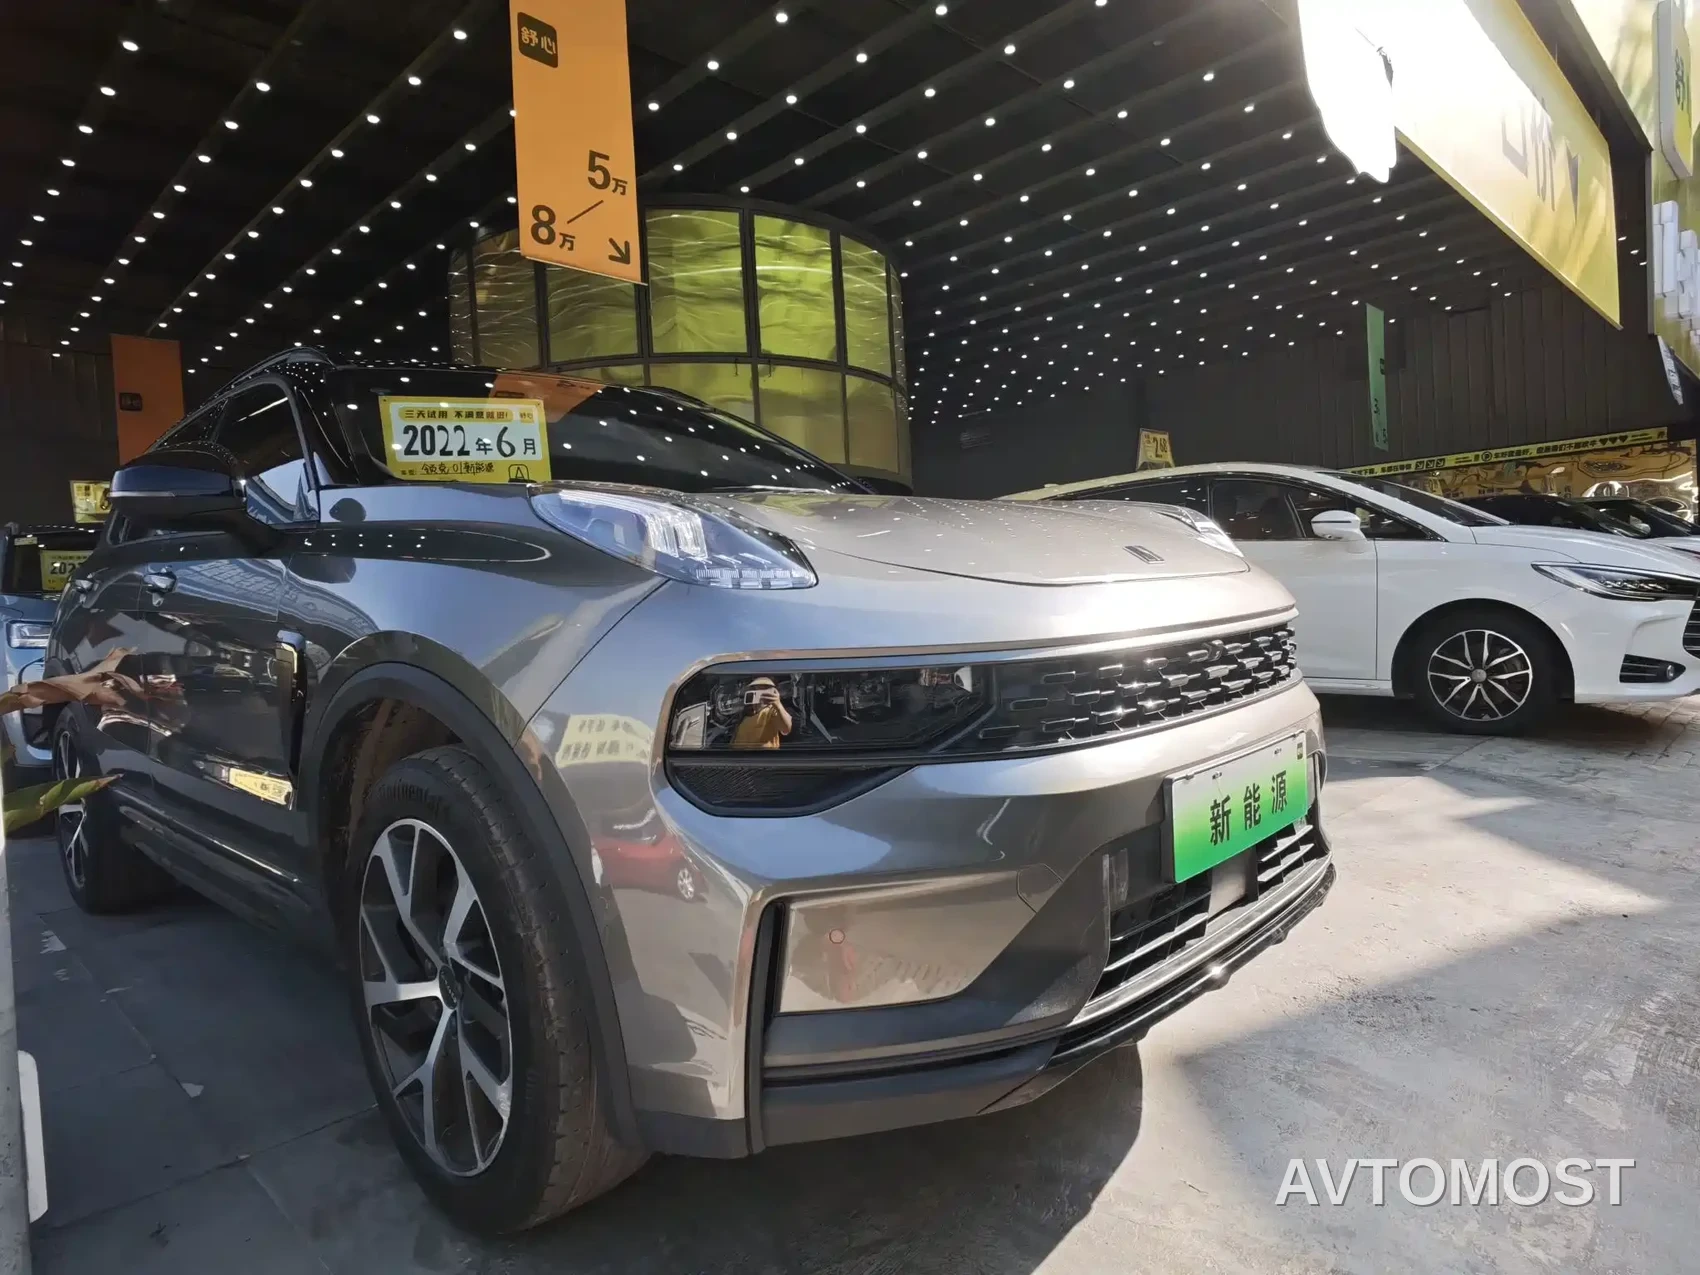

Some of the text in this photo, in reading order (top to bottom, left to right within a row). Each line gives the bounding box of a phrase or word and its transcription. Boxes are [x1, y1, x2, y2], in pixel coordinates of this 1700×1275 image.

[520, 26, 557, 55] 舒心
[587, 150, 628, 196] 5万
[530, 204, 576, 251] 8万
[1209, 770, 1288, 846] 新能源
